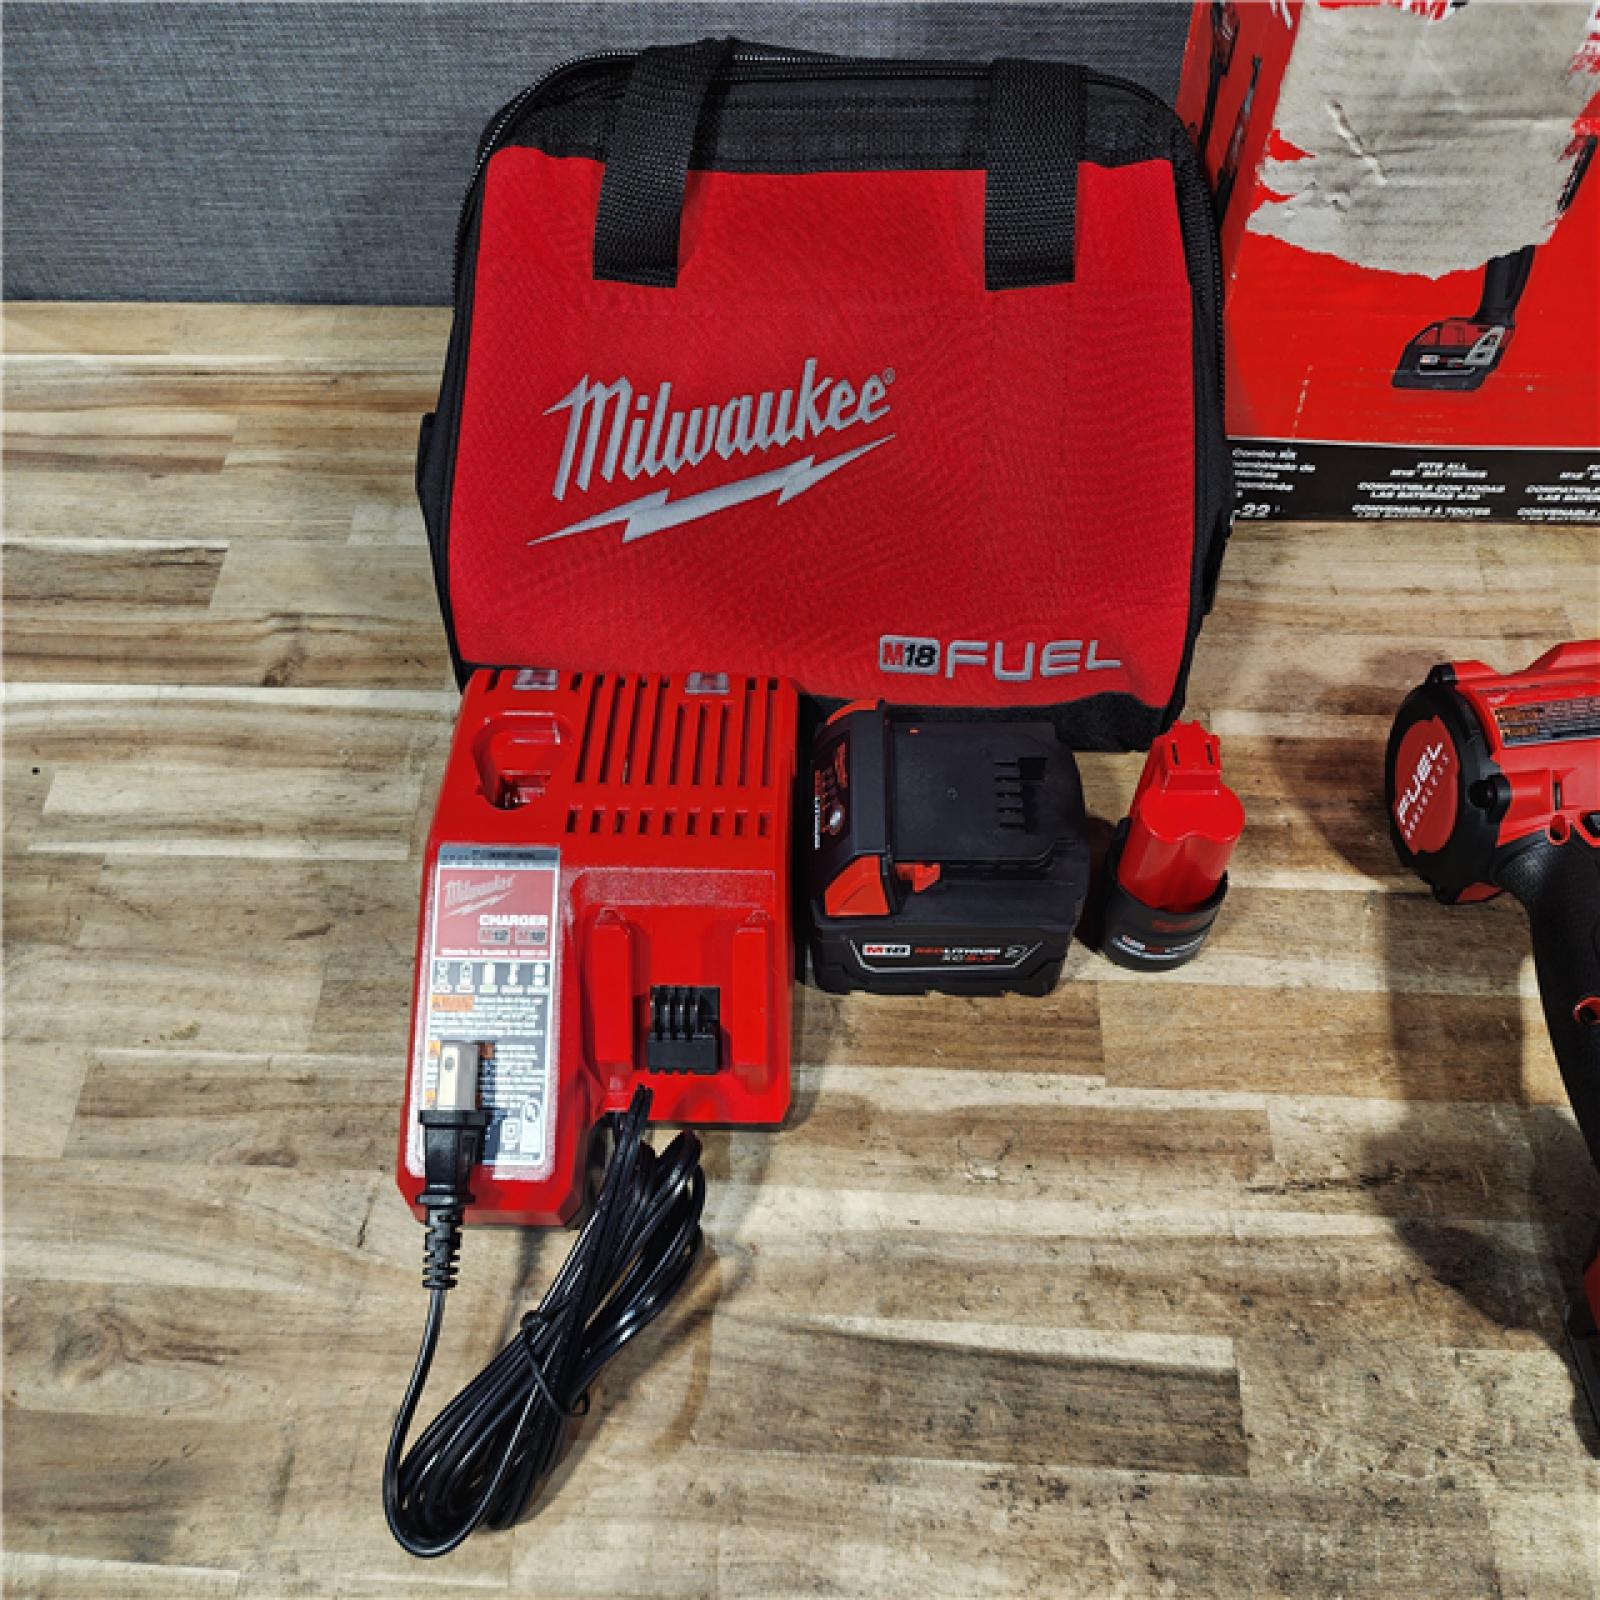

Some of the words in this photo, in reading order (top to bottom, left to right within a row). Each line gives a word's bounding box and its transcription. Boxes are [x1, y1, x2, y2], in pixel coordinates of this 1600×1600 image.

[881, 640, 938, 671] M18
[945, 639, 1121, 680] FUEL
[1398, 741, 1443, 825] FUEL
